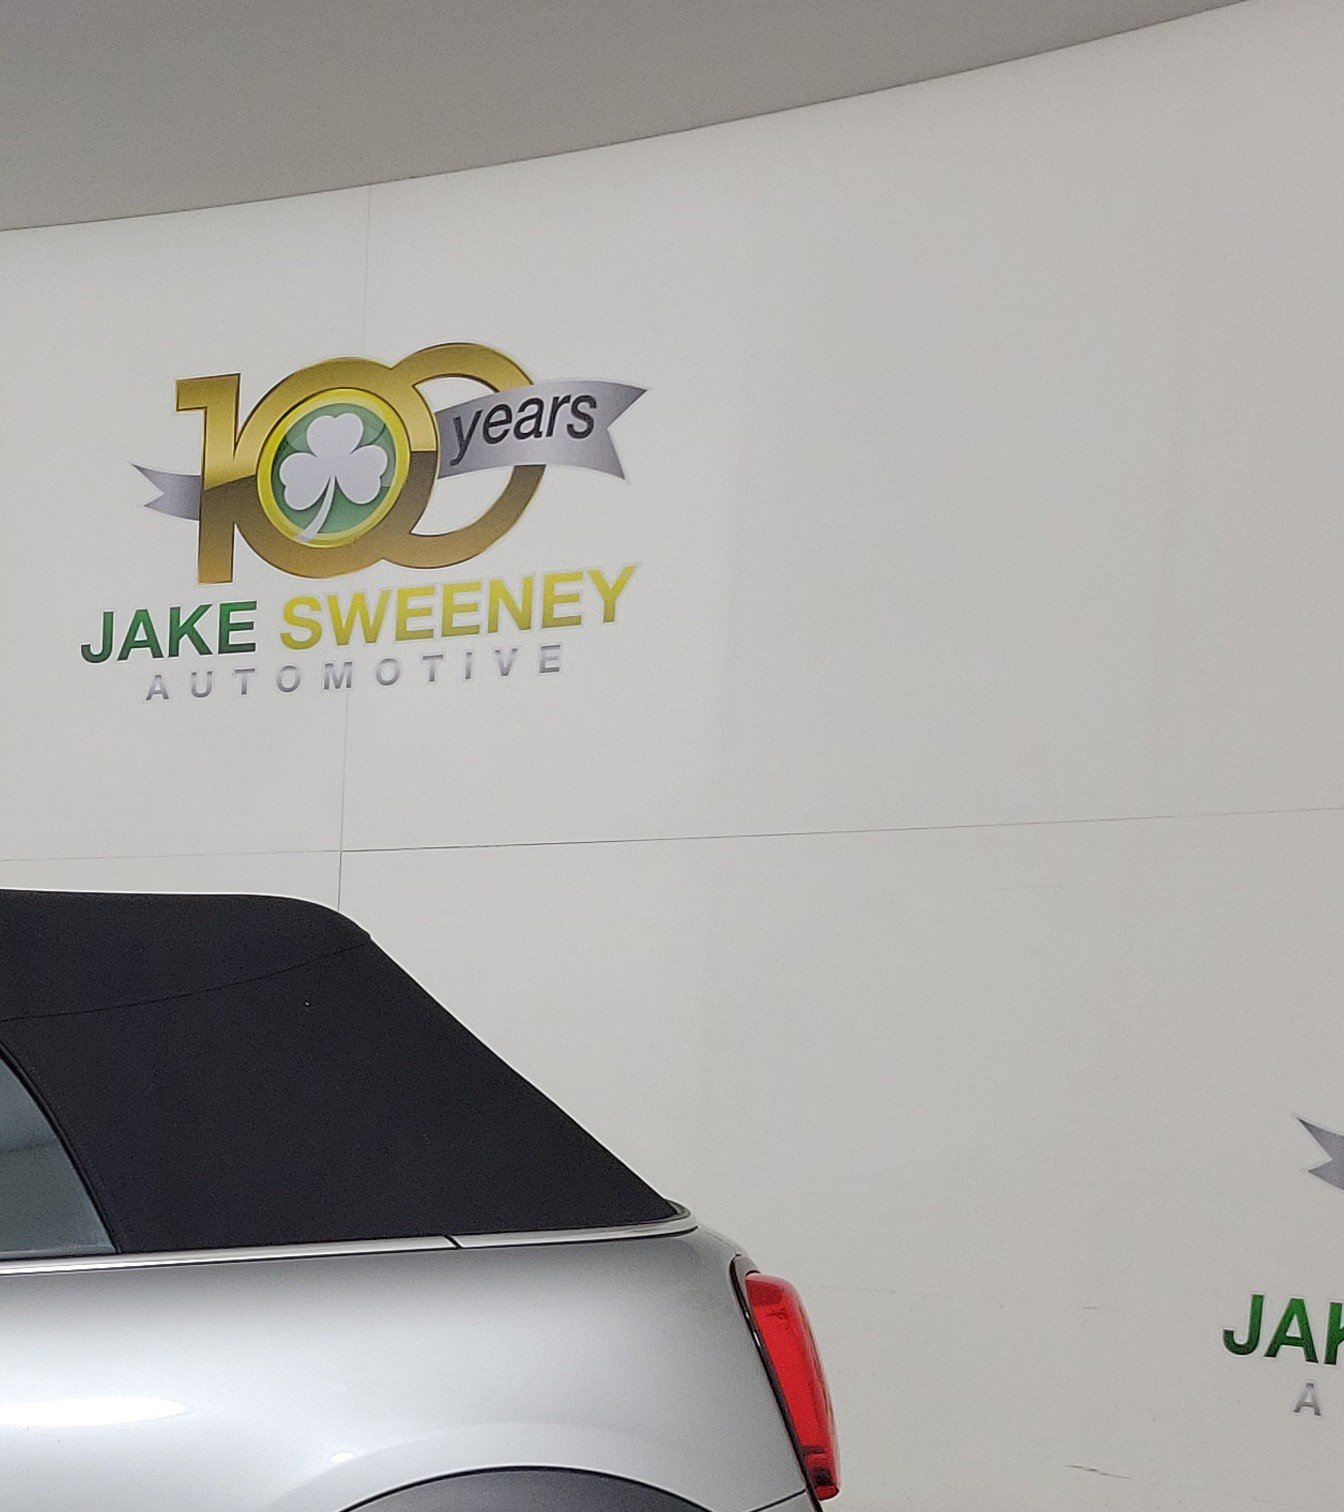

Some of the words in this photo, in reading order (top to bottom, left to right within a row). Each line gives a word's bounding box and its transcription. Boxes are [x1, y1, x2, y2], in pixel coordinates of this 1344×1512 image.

[176, 342, 547, 584] 100
[450, 395, 597, 465] years
[80, 600, 258, 663] JAKE
[279, 564, 637, 651] SWEENEY
[145, 644, 562, 701] AUTOMOTIVE
